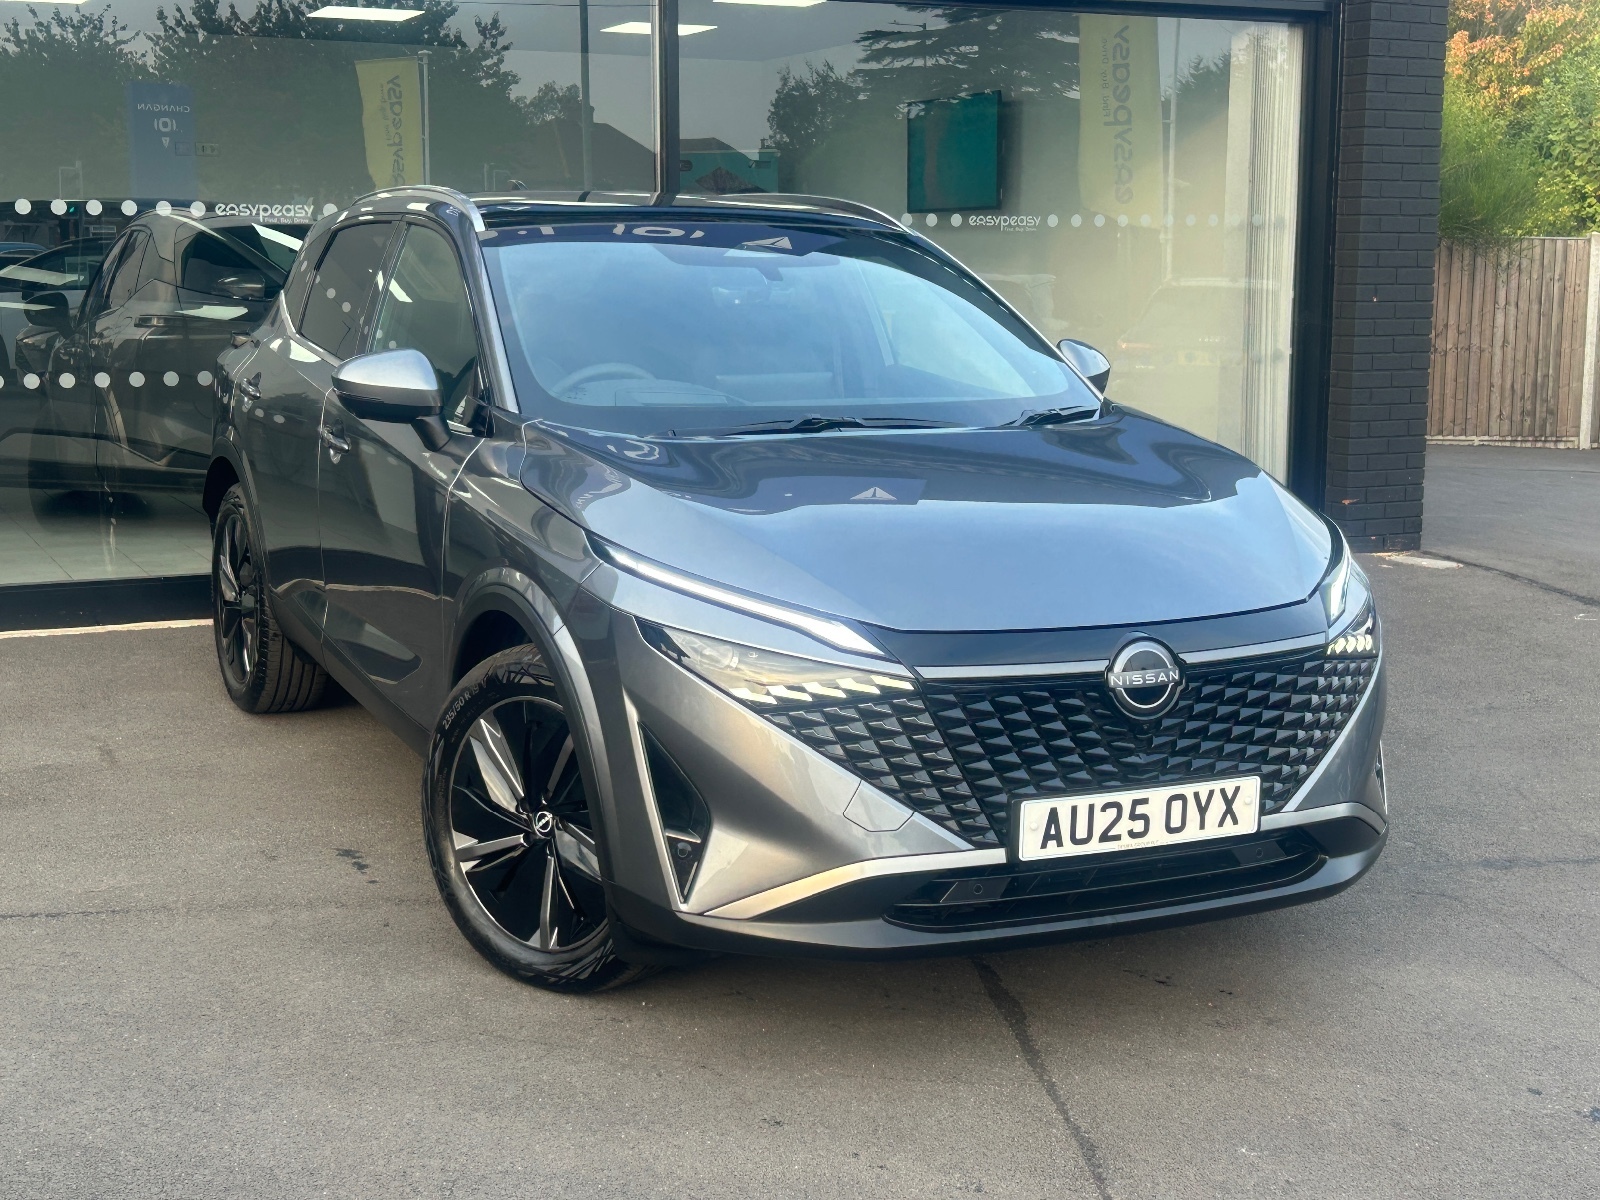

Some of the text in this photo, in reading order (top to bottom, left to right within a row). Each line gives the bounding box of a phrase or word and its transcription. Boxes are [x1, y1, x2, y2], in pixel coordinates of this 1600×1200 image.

[215, 203, 314, 222] easypeasy
[968, 215, 1041, 231] easypeasy
[1110, 670, 1179, 686] NISSAN
[443, 697, 465, 729] 235/50
[1040, 786, 1241, 849] AU25 OYX
